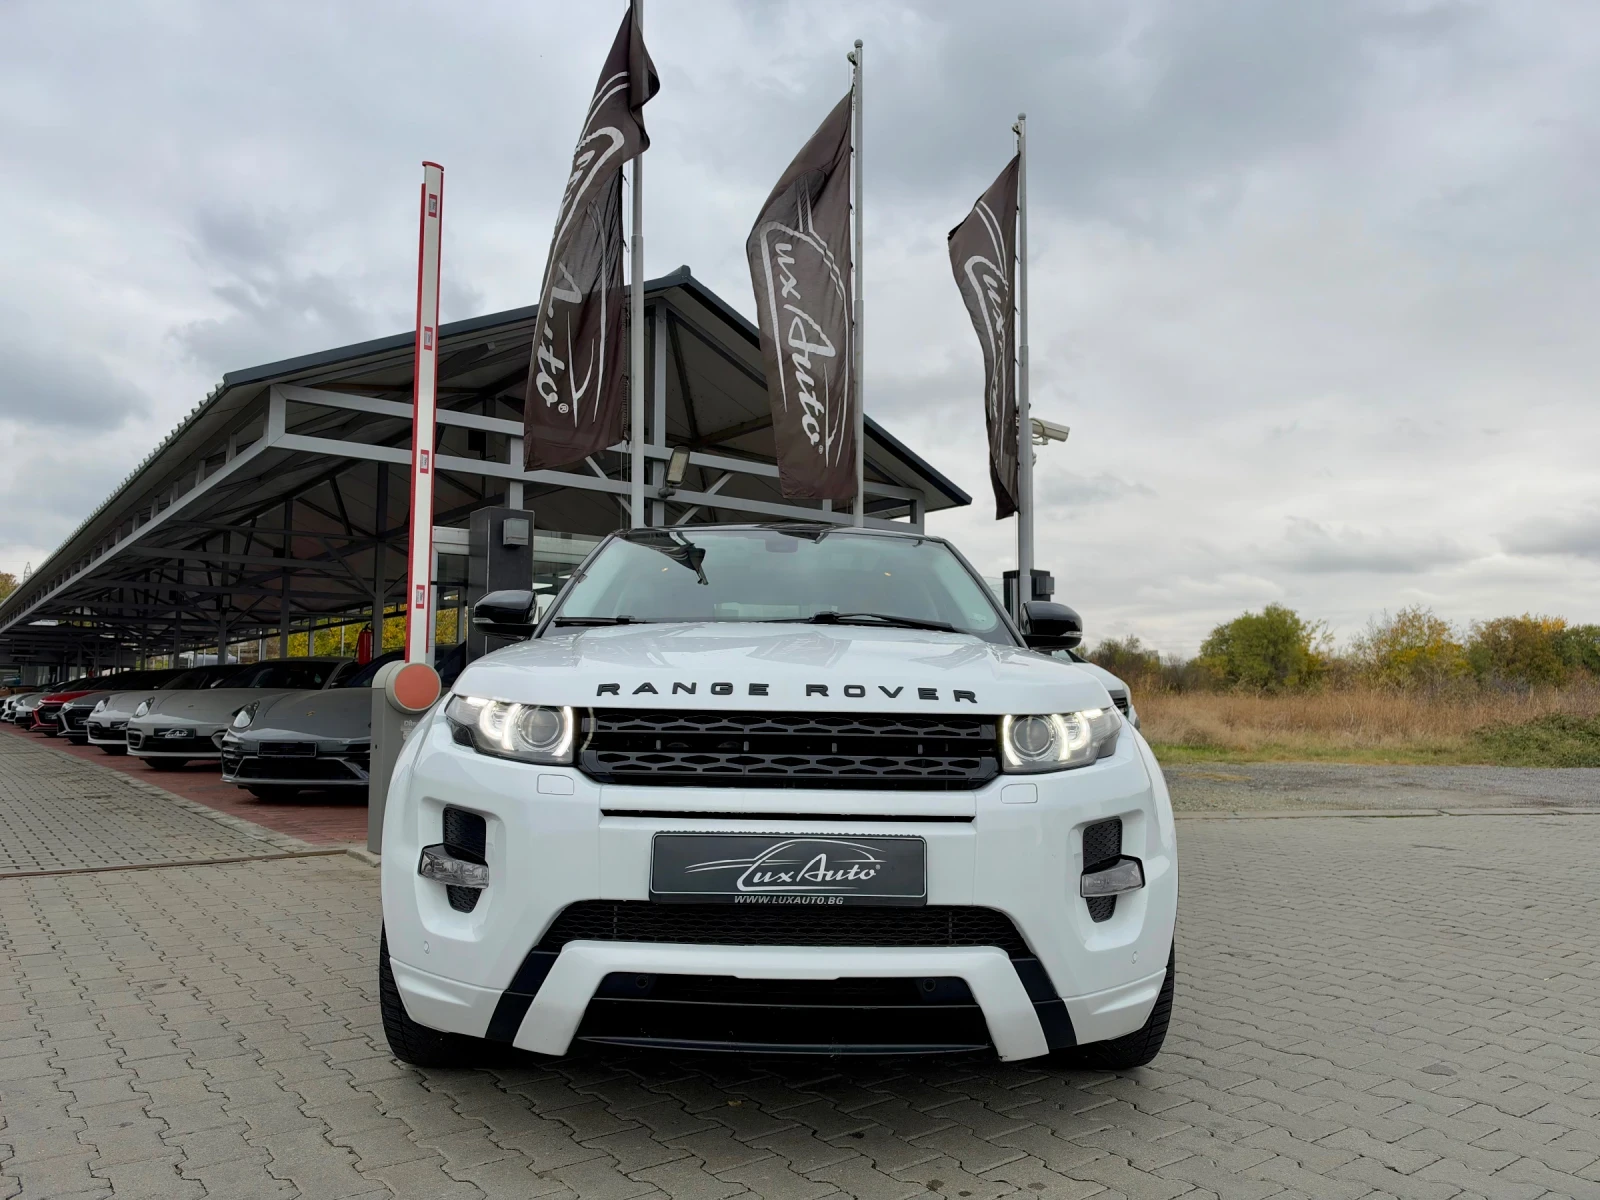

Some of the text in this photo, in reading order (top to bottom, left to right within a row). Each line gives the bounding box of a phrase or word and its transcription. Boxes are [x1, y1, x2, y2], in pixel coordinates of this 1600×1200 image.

[596, 682, 978, 704] RANGE ROVER
[734, 895, 844, 905] WWW.LUXAUTO.BG
